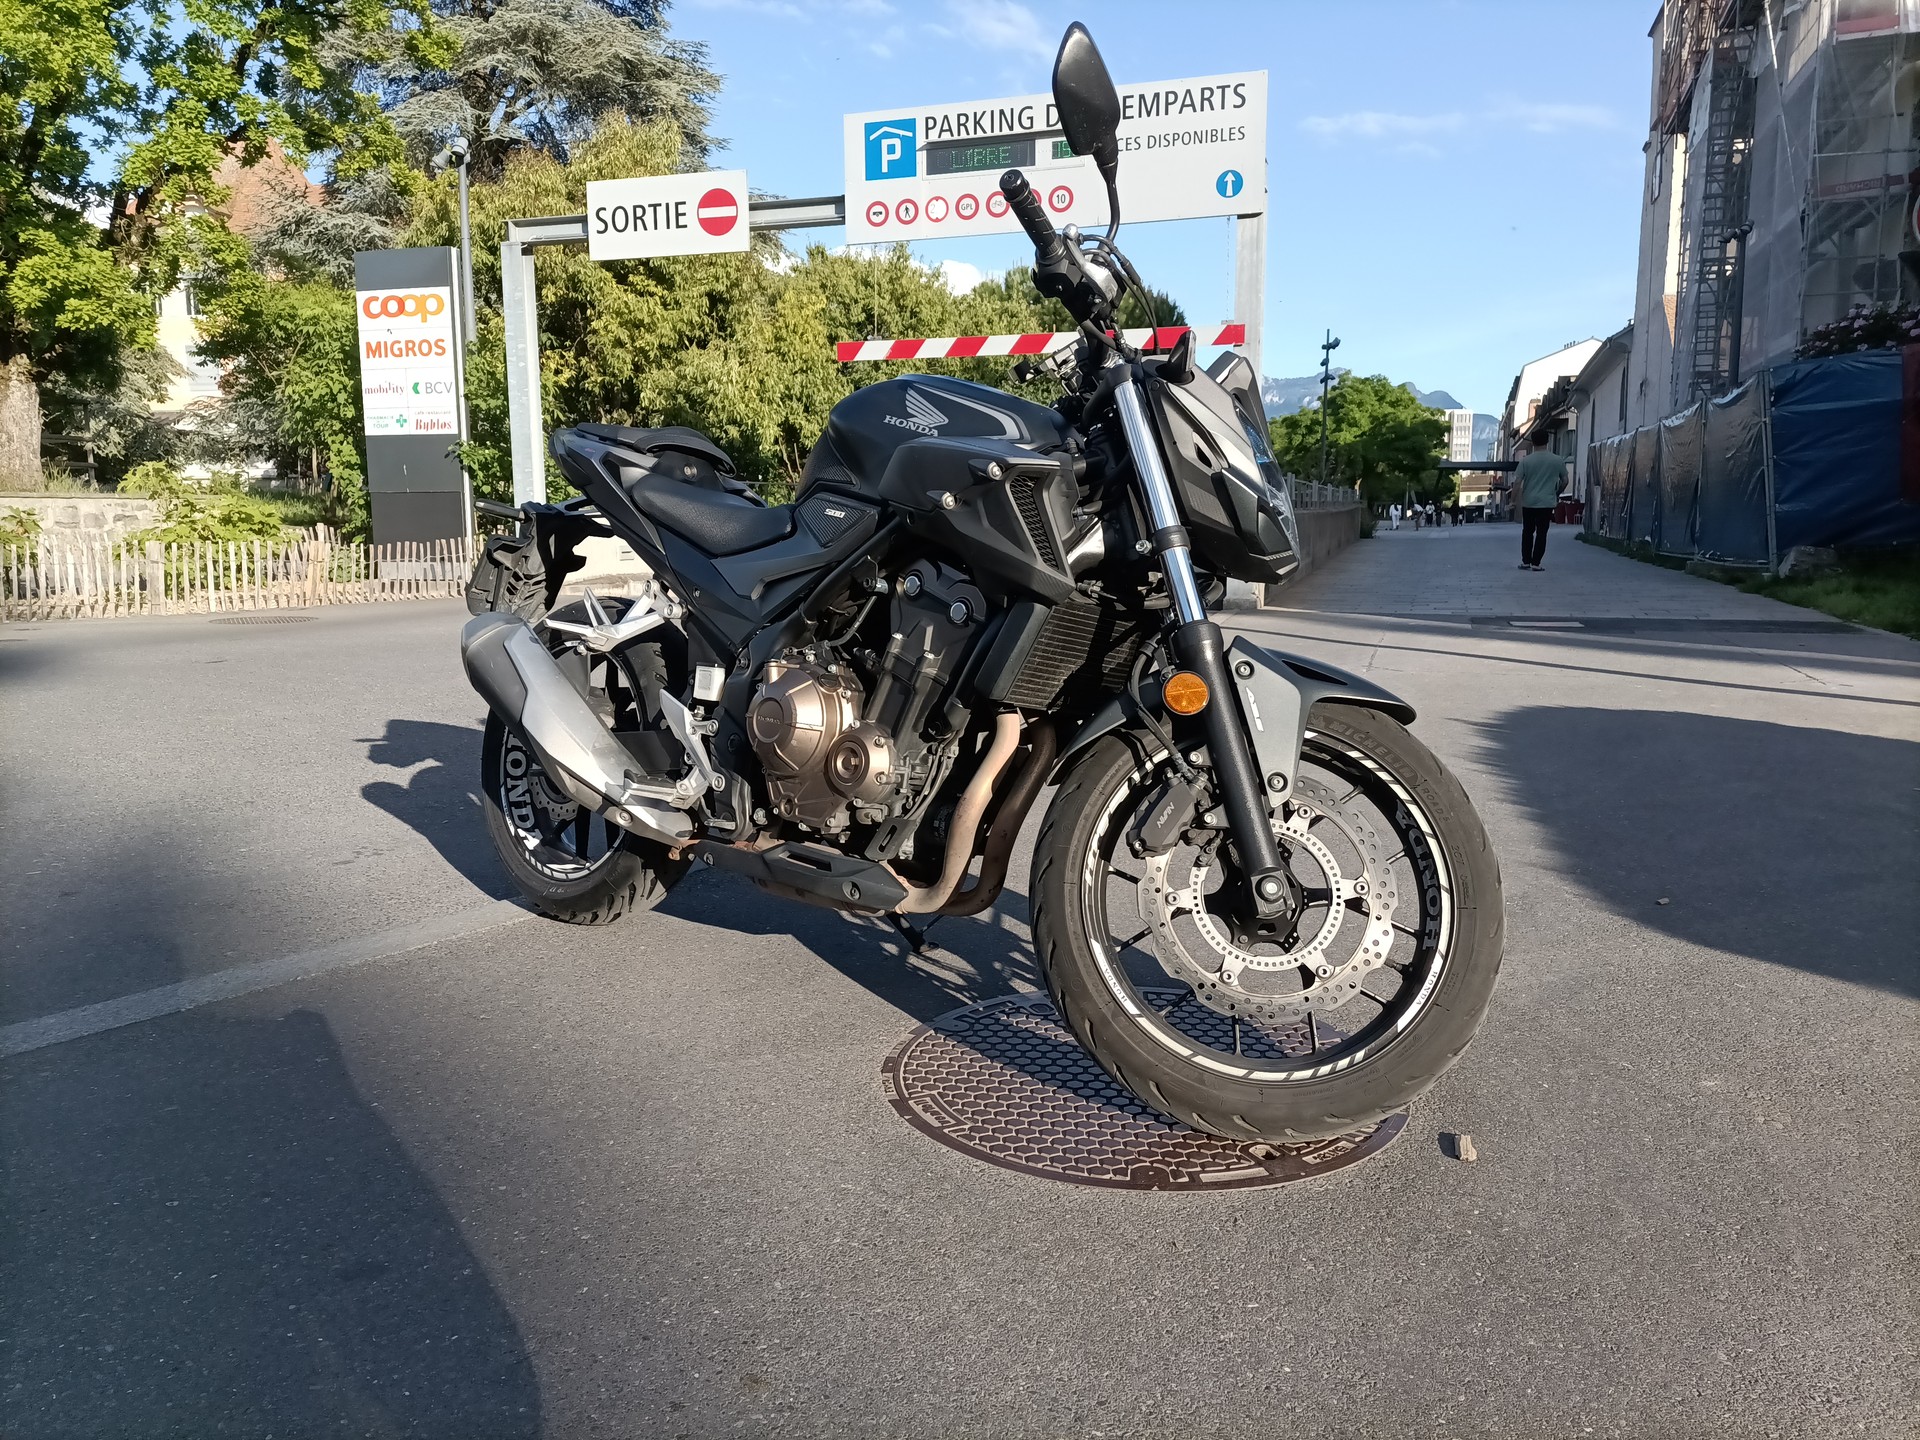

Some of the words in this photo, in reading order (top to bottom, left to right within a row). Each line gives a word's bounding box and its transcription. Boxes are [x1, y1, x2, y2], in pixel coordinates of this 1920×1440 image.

[924, 106, 1034, 139] PARKING
[1122, 83, 1247, 120] EMPARTS
[1147, 126, 1246, 149] DISPONIBLES
[881, 138, 902, 173] P
[960, 203, 974, 211] GPL
[1056, 193, 1067, 204] 10
[595, 201, 688, 234] SORTIE
[363, 293, 445, 323] coop
[365, 338, 446, 359] MIGROS
[364, 381, 405, 396] mobility
[425, 382, 453, 395] BCV
[883, 414, 938, 437] HONDA
[1395, 799, 1442, 950] HONDA
[1415, 970, 1438, 1006] HONDA
